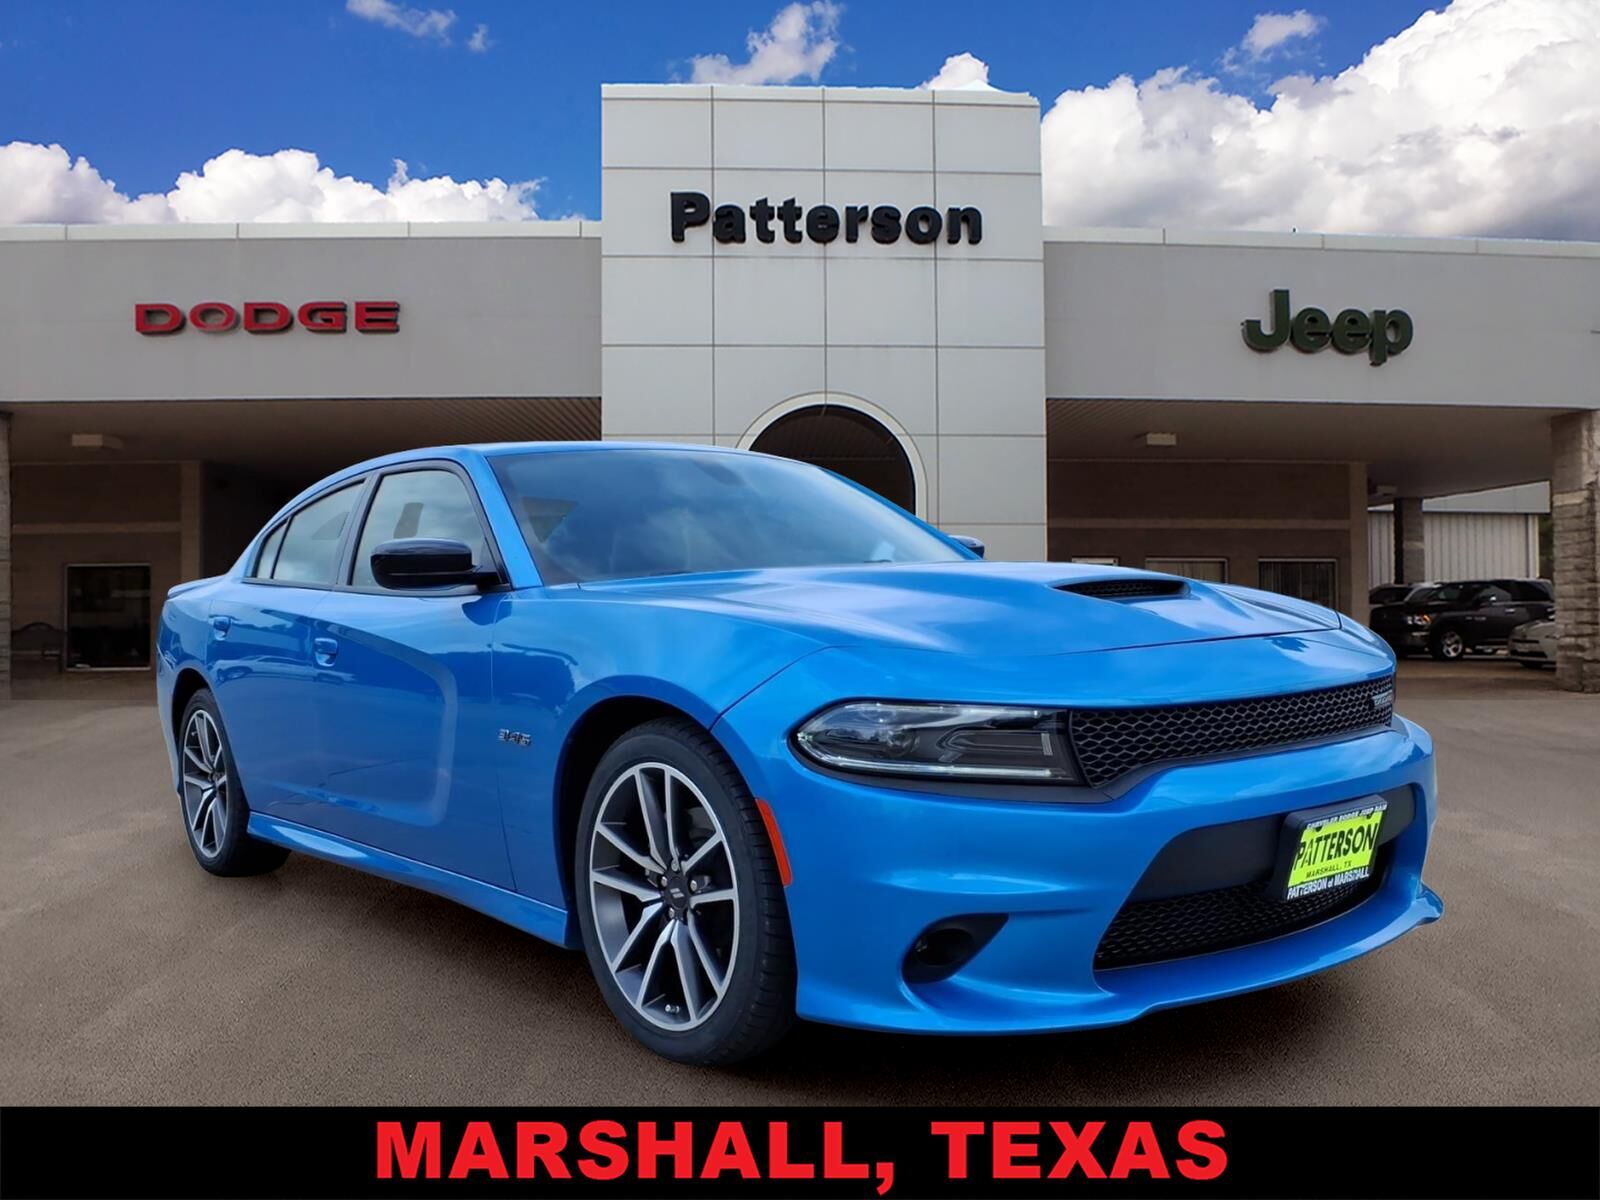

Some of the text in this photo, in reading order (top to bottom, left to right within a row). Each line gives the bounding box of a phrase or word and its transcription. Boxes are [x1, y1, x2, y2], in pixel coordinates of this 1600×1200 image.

[670, 191, 983, 245] Patterson
[135, 302, 400, 334] DODGE
[1240, 289, 1414, 367] Jeep
[1294, 822, 1378, 871] PATTERSON
